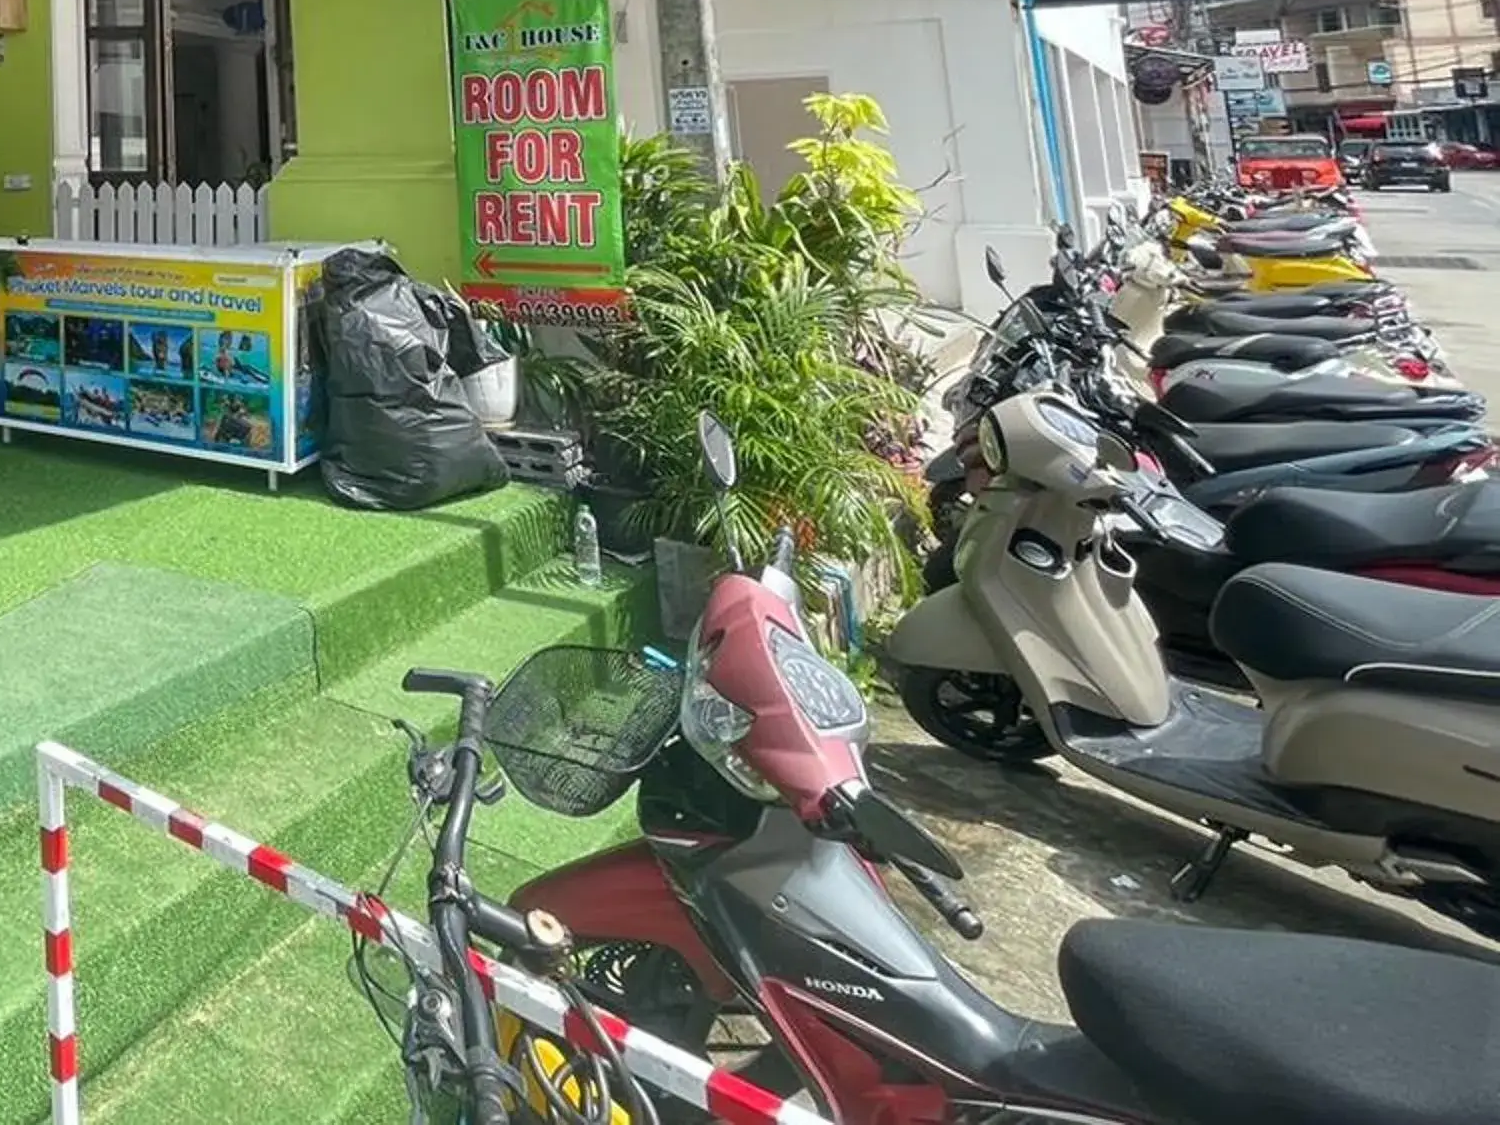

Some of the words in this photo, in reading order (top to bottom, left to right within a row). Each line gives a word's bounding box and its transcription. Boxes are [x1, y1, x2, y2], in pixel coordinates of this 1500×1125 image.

[520, 23, 600, 48] HOUSE
[461, 66, 607, 124] ROOM
[486, 128, 585, 184] FOR
[475, 191, 601, 246] RENT
[64, 279, 125, 297] Marvels
[129, 285, 165, 300] tour
[169, 287, 203, 305] and
[208, 292, 263, 314] travel
[804, 975, 885, 1002] HONDA
